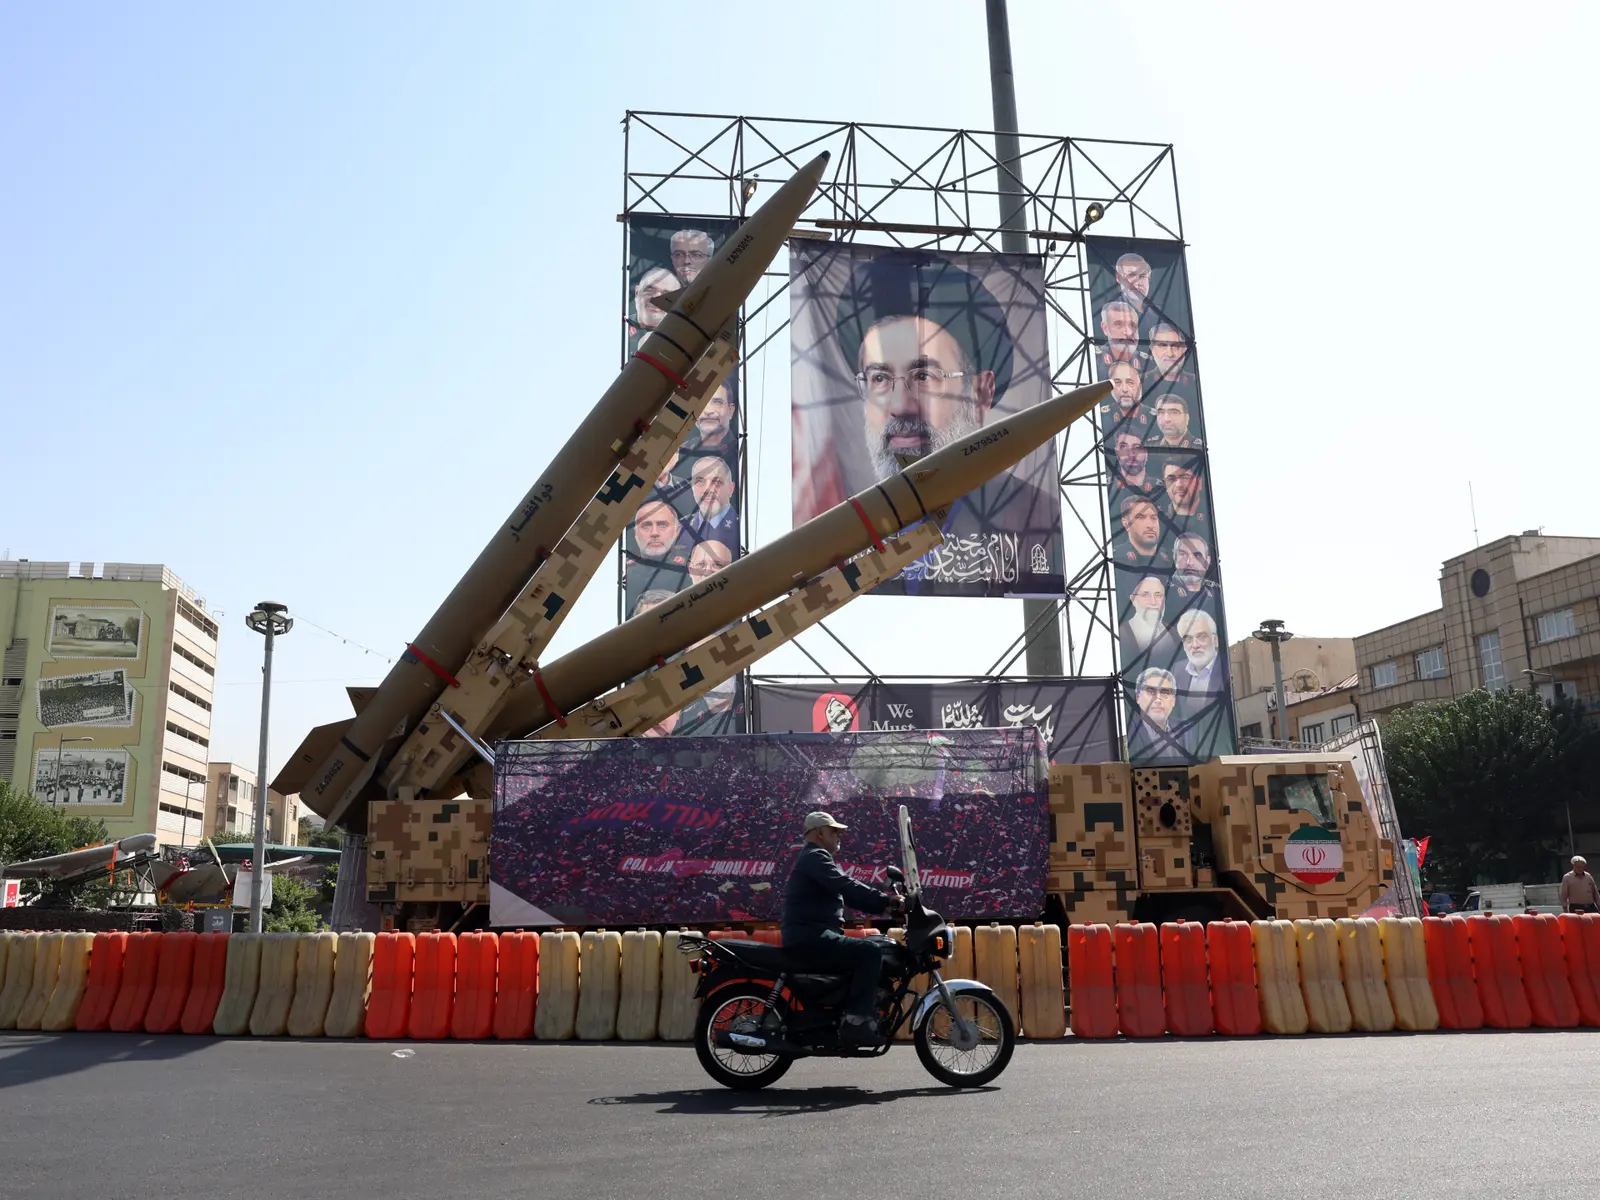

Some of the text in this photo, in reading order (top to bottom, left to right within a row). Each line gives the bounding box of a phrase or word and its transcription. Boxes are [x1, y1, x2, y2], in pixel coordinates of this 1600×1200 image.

[961, 428, 1010, 456] ZA795214
[887, 703, 914, 719] We
[660, 803, 725, 829] KILL
[749, 861, 775, 876] HEY
[920, 869, 976, 888] Trump!
